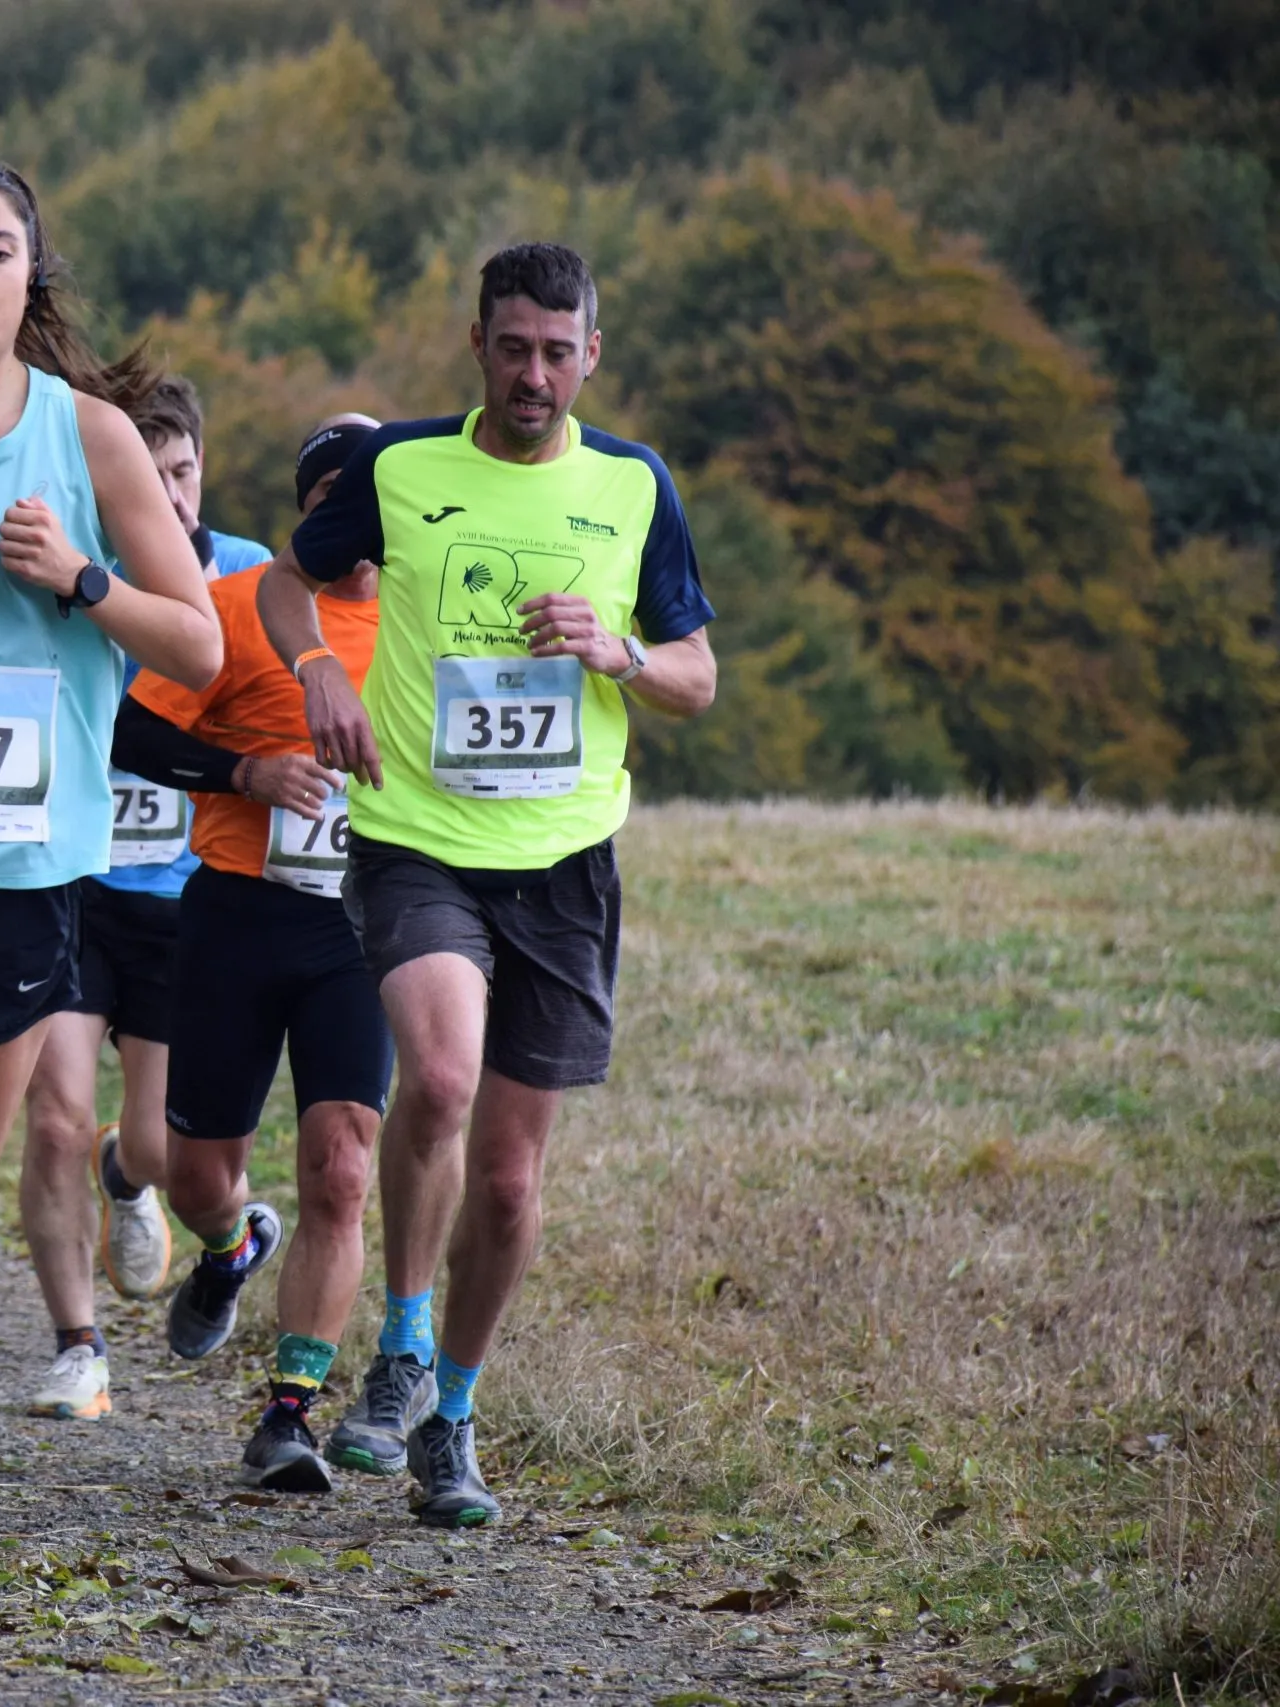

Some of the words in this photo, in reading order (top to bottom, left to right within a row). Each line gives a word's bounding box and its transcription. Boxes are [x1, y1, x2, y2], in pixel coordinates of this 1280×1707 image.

[456, 531, 477, 541] XVIII
[452, 630, 482, 644] Media
[466, 705, 556, 750] 357
